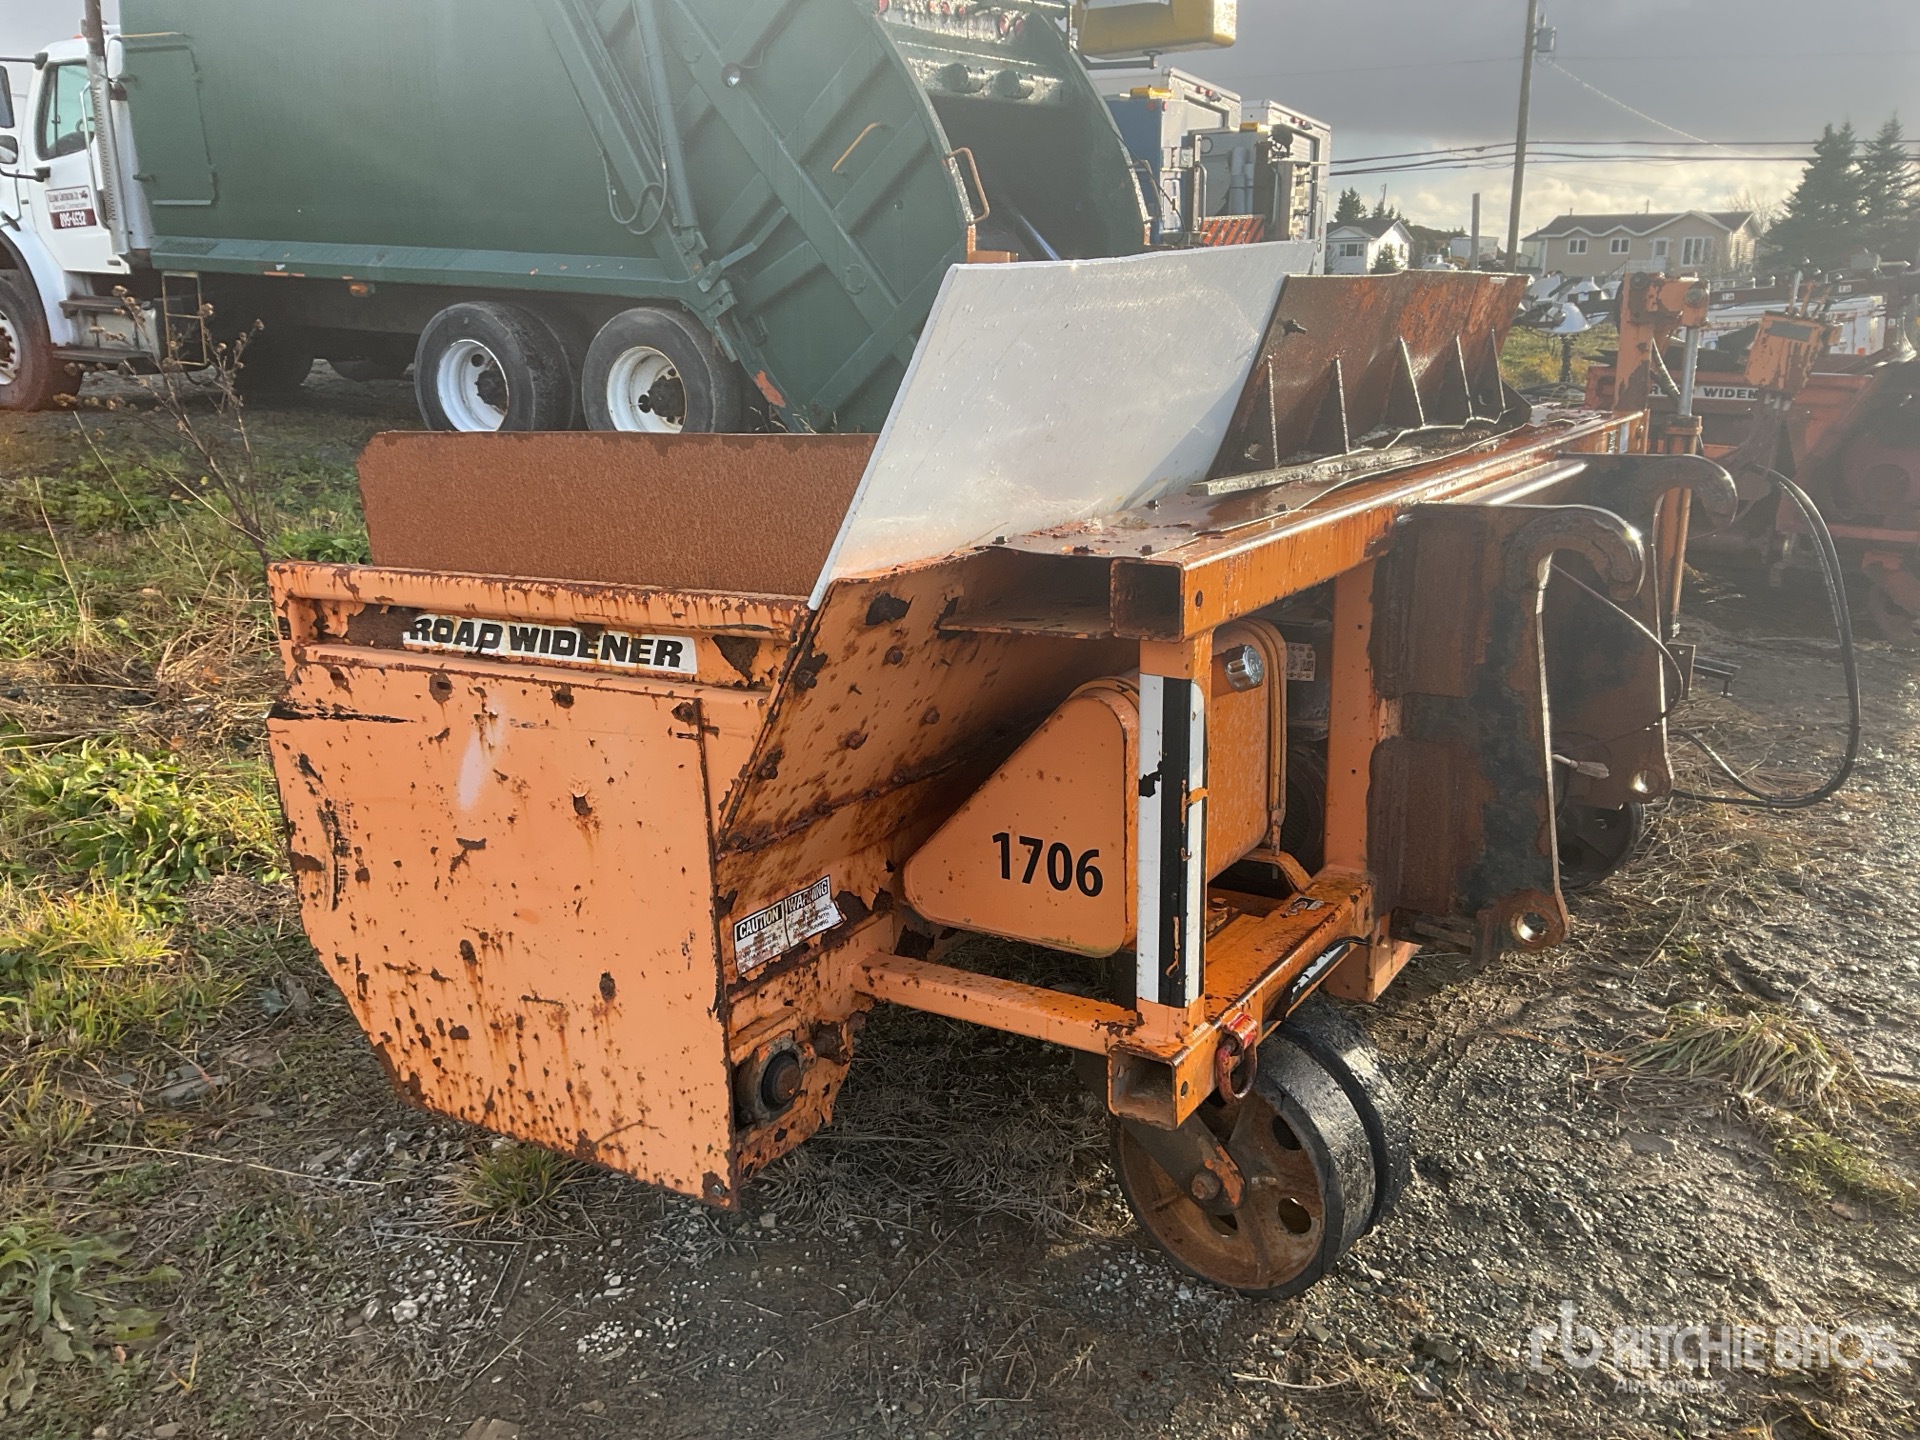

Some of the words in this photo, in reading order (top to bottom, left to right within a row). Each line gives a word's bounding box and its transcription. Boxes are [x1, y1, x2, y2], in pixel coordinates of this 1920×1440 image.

[1703, 387, 1757, 399] WIDEN
[408, 617, 503, 651] ROAD
[508, 624, 684, 668] WIDENER
[992, 831, 1104, 897] 1706
[739, 906, 780, 939] CAUTION
